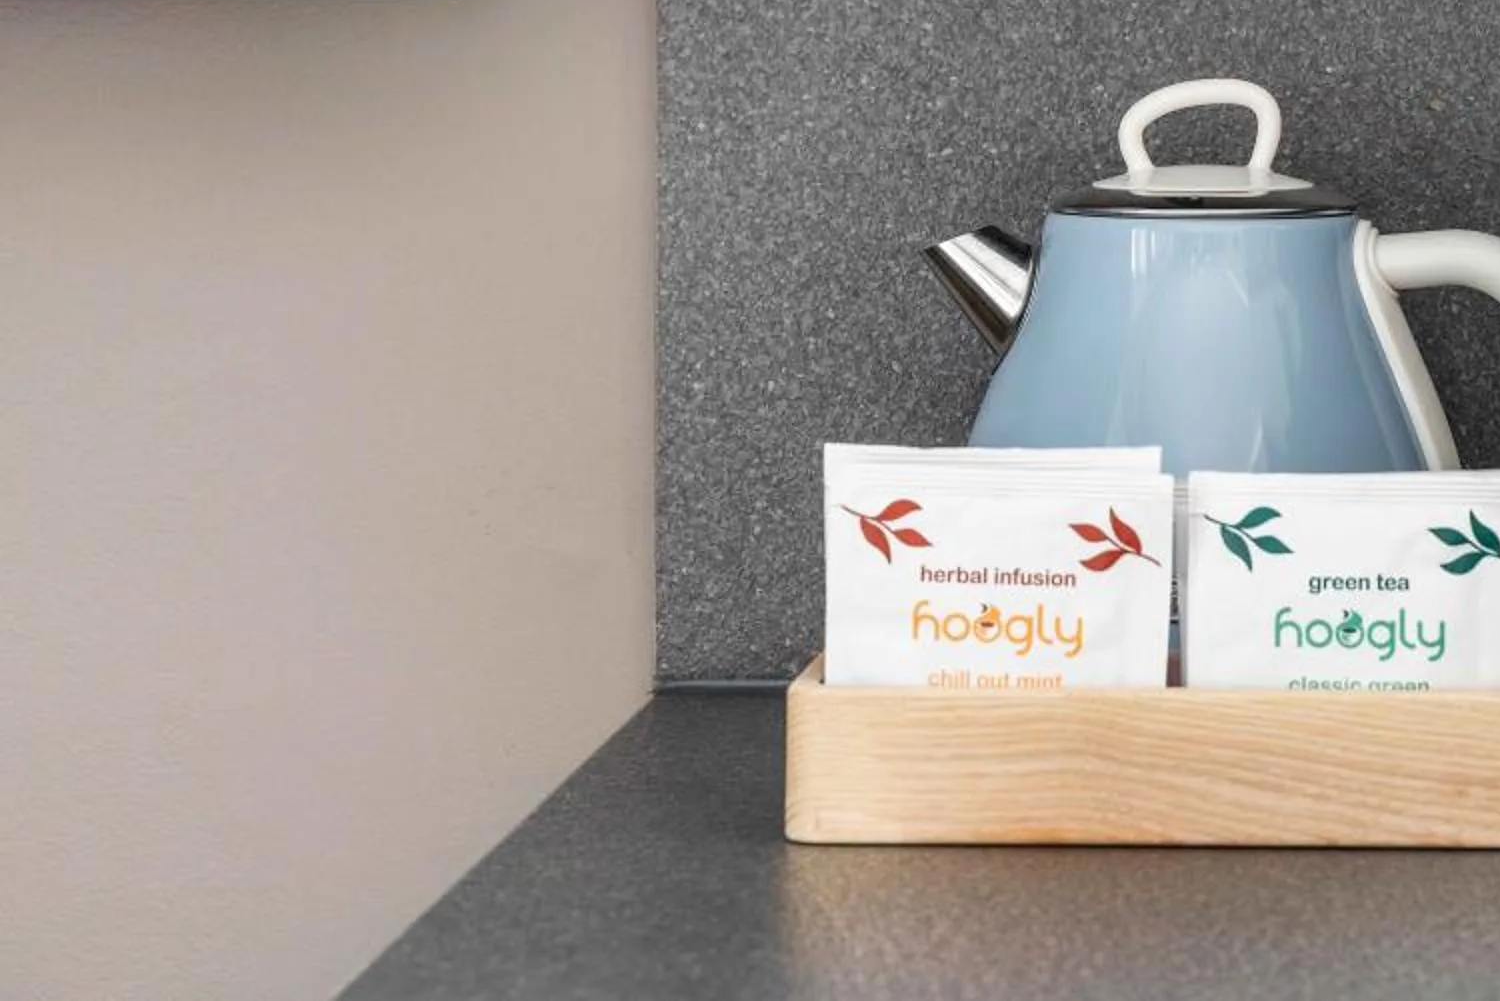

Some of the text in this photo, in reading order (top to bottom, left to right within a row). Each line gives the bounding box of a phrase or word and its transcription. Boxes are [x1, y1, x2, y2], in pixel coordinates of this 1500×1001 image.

[920, 564, 1077, 588] herbal infusion
[1309, 574, 1410, 594] green tea
[912, 599, 1083, 658] hoogly
[1274, 606, 1446, 662] hoogly
[928, 669, 1063, 690] chill out mint
